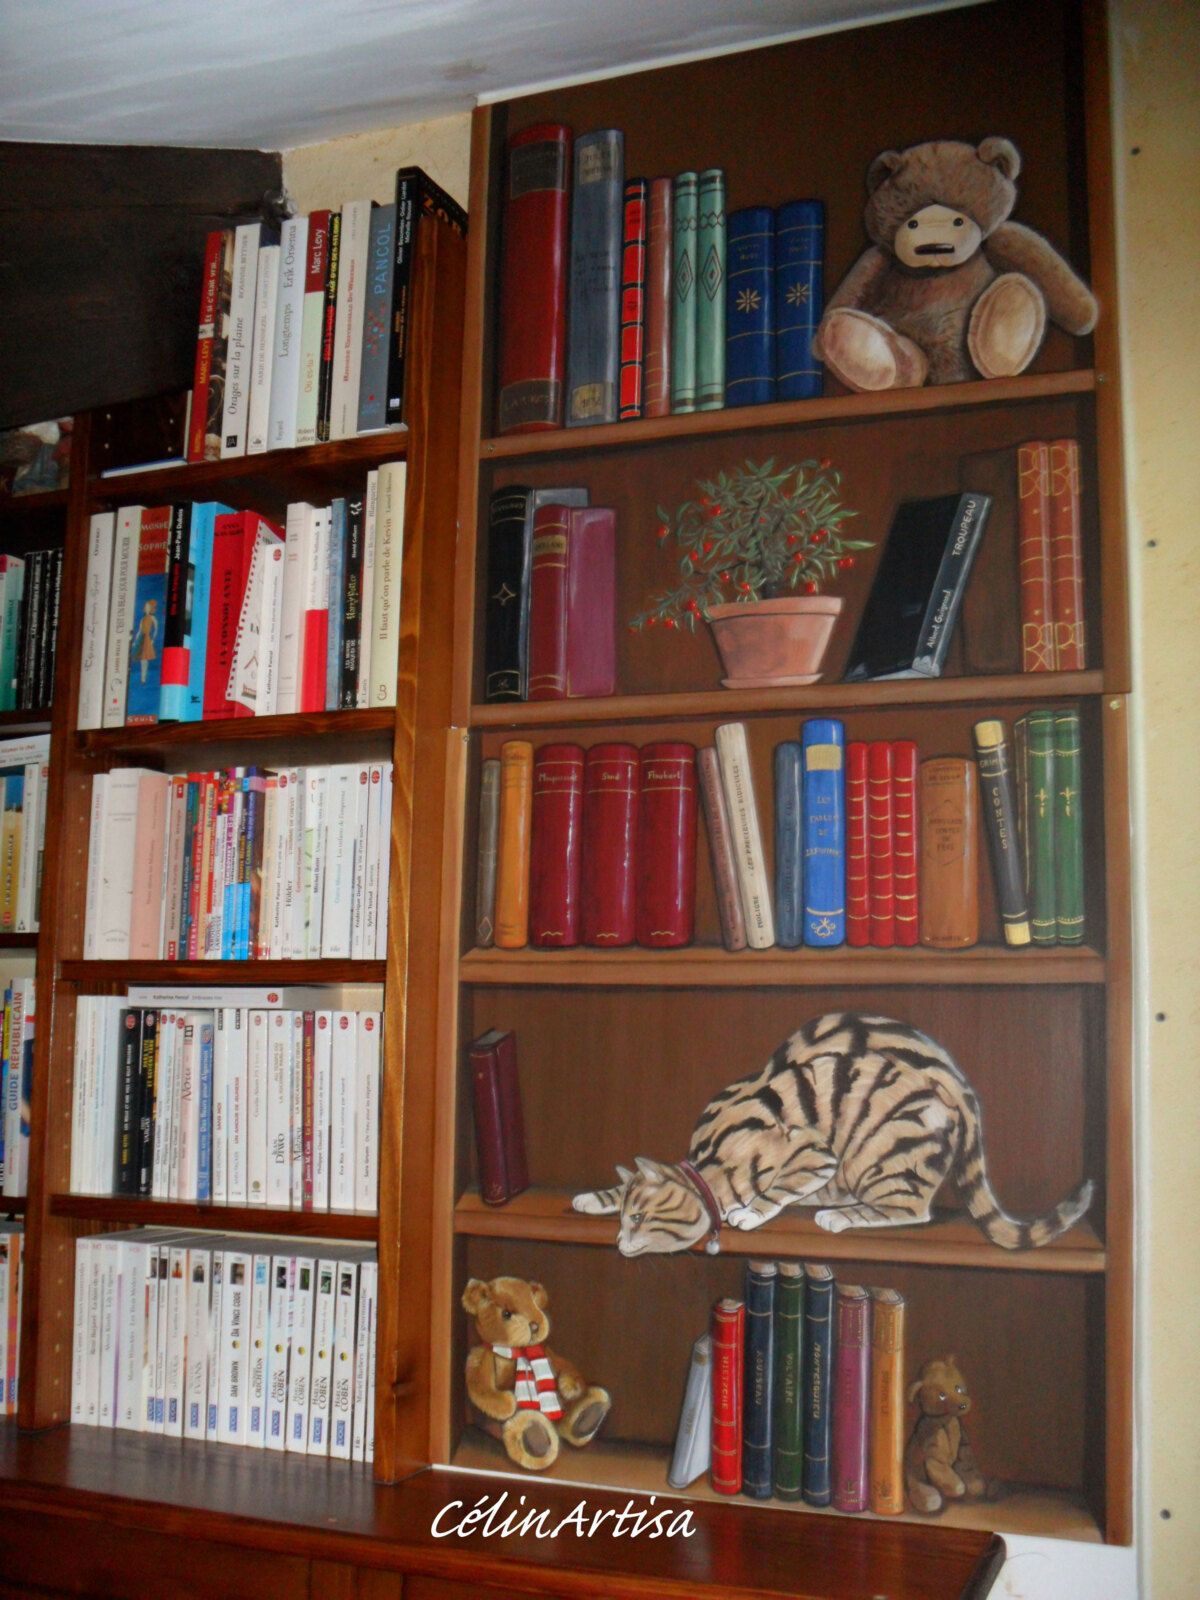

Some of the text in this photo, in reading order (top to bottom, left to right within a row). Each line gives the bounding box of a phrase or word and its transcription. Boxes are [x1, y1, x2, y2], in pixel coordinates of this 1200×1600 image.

[283, 225, 296, 288] Erik Orsenna
[311, 228, 326, 274] Marc Levy
[374, 222, 391, 295] PANCOL
[278, 304, 293, 358] Longtemps
[200, 340, 210, 384] MARC LEVY
[227, 317, 245, 415] Orages sur la plaine
[175, 509, 184, 530] Dubois
[383, 518, 392, 545] Kevin
[952, 500, 977, 557] TROUPEAU
[173, 531, 182, 560] Jean-Paul
[382, 547, 391, 560] de
[382, 561, 393, 583] parle
[380, 584, 393, 611] qu'on
[379, 633, 388, 641] Il
[380, 612, 388, 632] faut
[991, 787, 1008, 849] CONTES
[8, 991, 22, 1111] GUIDE RÉPUBLICAIN
[230, 1360, 240, 1398] DAN BROWN
[255, 1357, 263, 1399] CRICHTON
[275, 1369, 285, 1404] COBEN
[296, 1376, 306, 1406] COBEN
[311, 1376, 327, 1410] HARLAN COBEN
[333, 1378, 349, 1413] HARLAN COBEN
